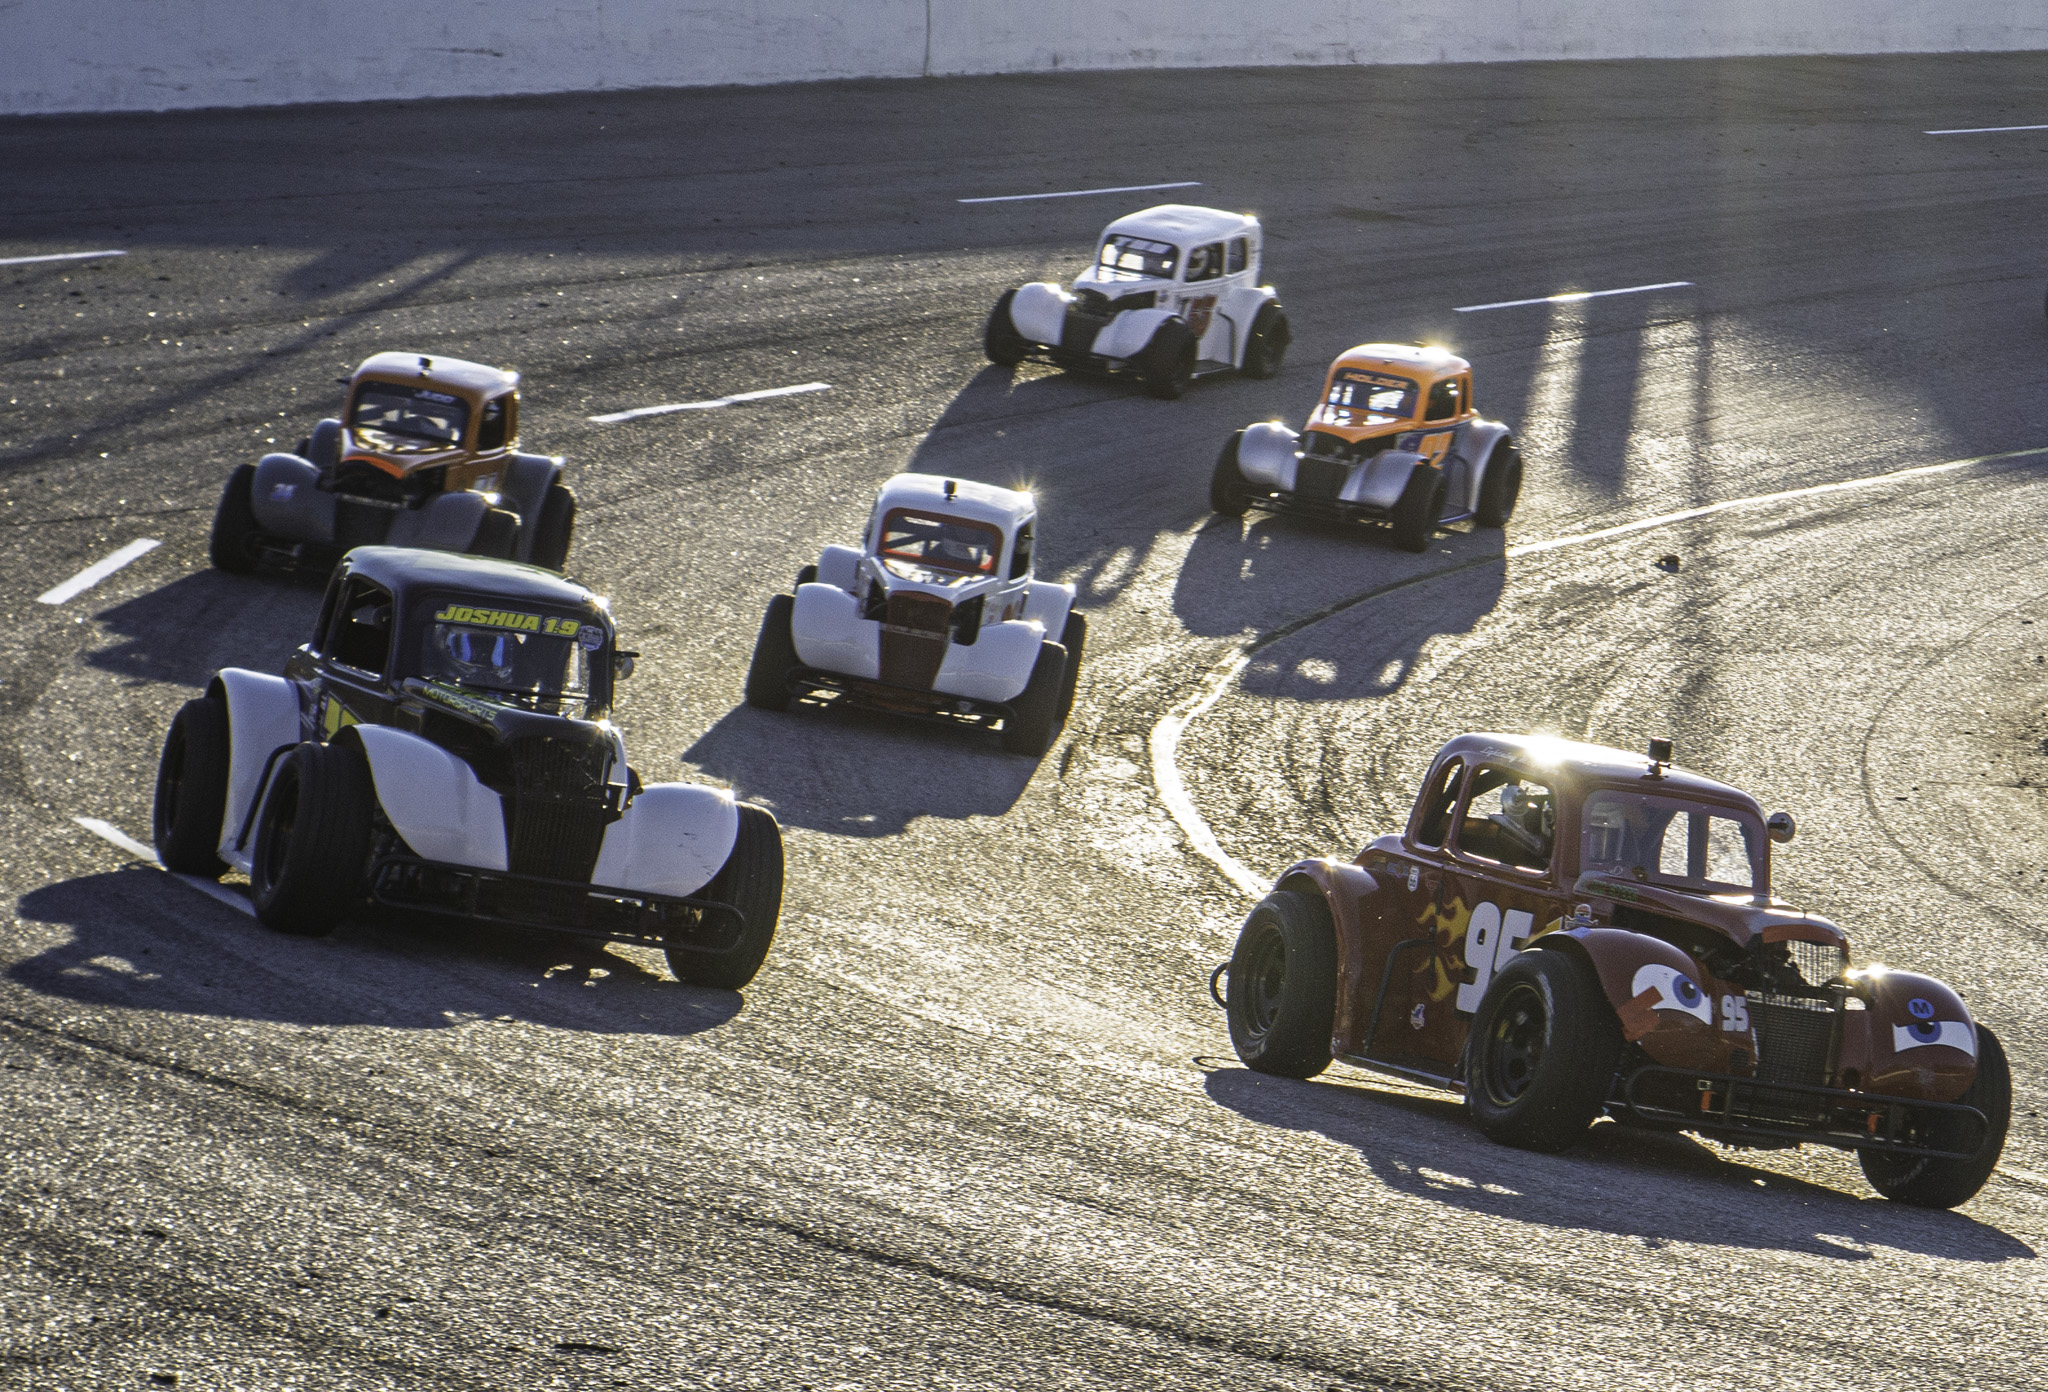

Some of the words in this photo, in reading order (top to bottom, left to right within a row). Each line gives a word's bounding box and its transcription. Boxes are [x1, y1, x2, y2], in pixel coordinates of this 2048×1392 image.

[436, 604, 541, 632] JOSHUA
[543, 616, 580, 638] 1:9
[421, 684, 499, 722] MOTORSPORTS
[1456, 901, 1534, 1014] 95
[1721, 994, 1749, 1032] 95
[1912, 1001, 1930, 1016] M
